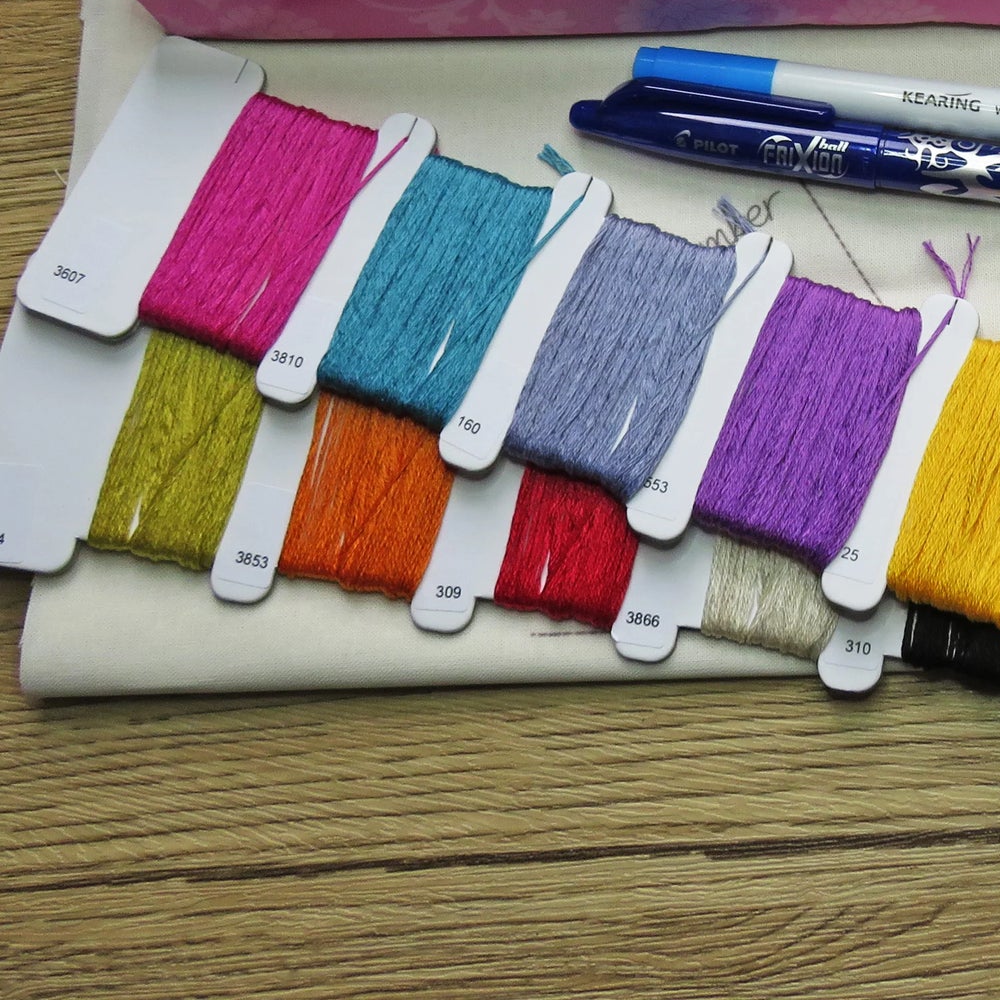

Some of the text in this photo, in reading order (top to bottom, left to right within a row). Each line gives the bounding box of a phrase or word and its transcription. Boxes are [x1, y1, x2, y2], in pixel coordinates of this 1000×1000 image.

[902, 90, 981, 112] KEARING
[693, 139, 739, 155] PILOT
[818, 138, 849, 152] ball
[53, 264, 86, 285] 3607
[271, 349, 304, 368] 3810
[457, 415, 482, 435] 160
[235, 550, 269, 570] 3853
[435, 585, 462, 600] 309
[626, 611, 660, 628] 3866
[845, 640, 871, 655] 310
